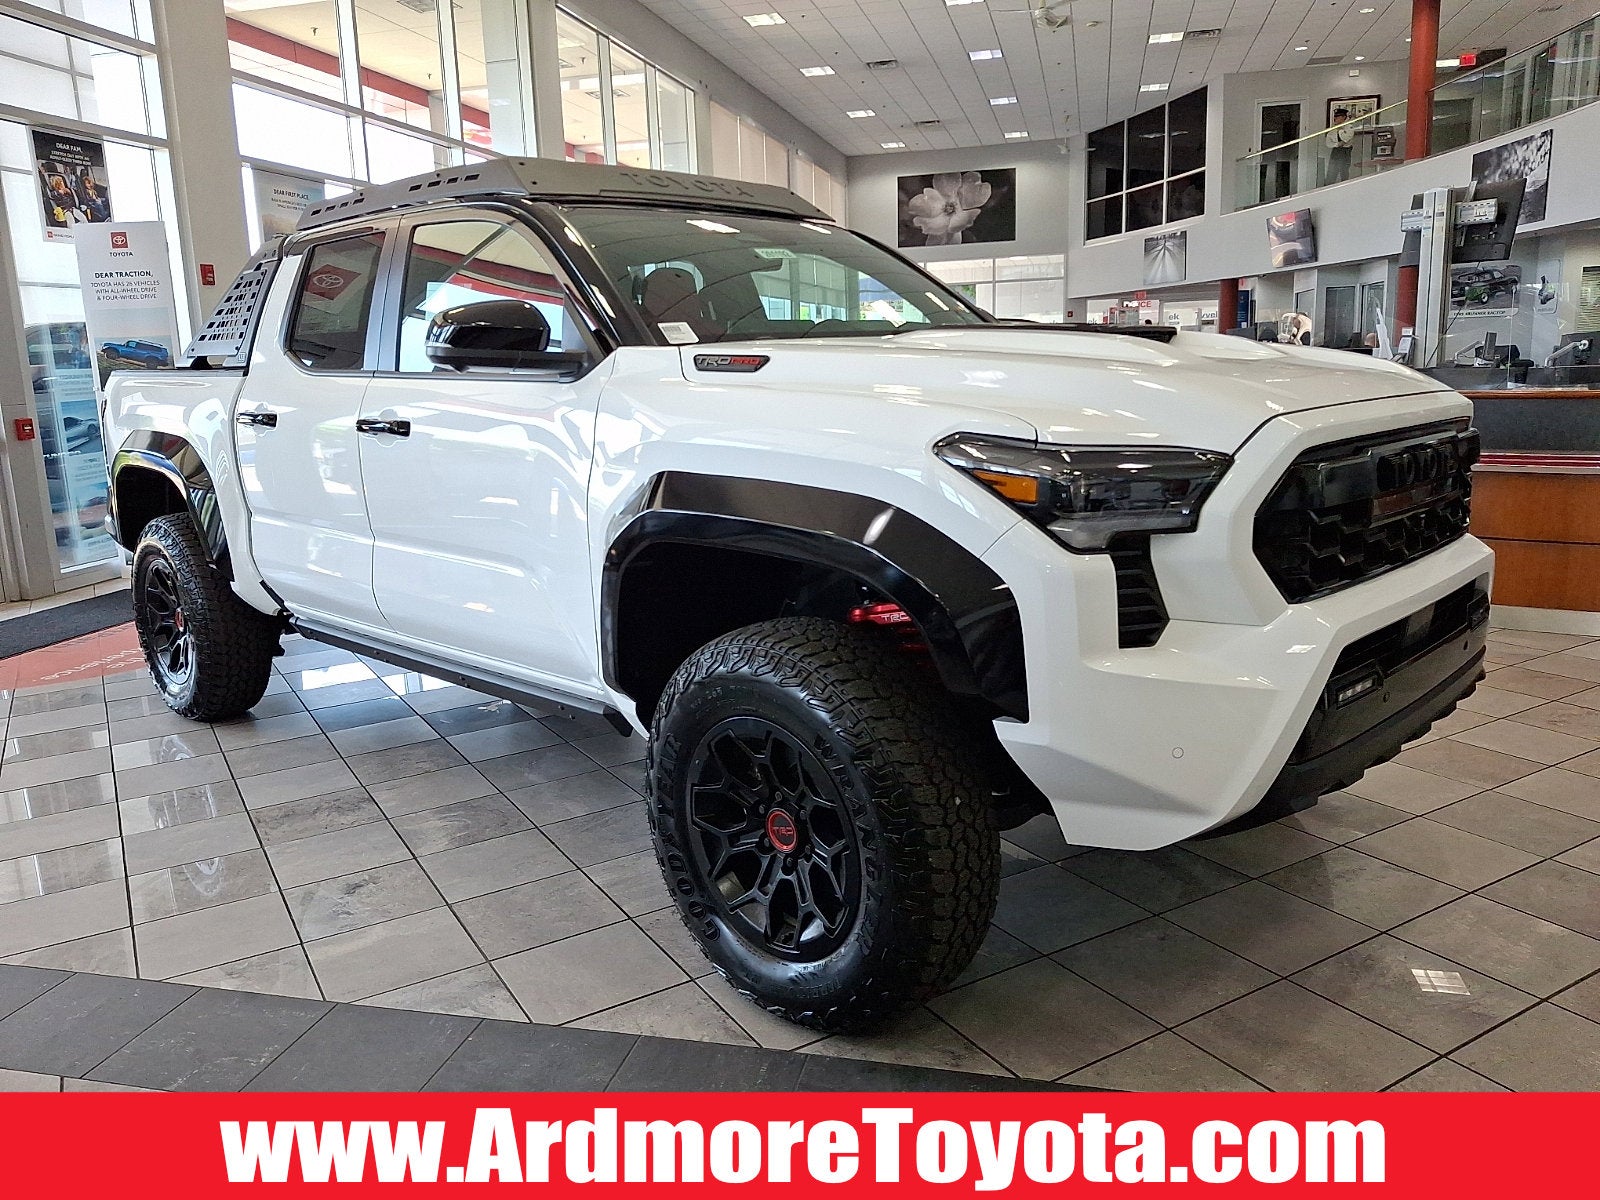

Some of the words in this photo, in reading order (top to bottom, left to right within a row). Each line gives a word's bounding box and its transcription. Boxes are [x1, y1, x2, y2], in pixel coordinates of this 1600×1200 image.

[56, 143, 70, 151] DEAR
[620, 172, 755, 198] TOYOTA
[94, 271, 114, 279] DEAR
[115, 270, 154, 278] TRACTION,
[695, 355, 731, 367] TRD
[656, 732, 721, 942] GOODYEAR
[772, 826, 794, 836] TRD
[812, 733, 881, 957] WRANGLER
